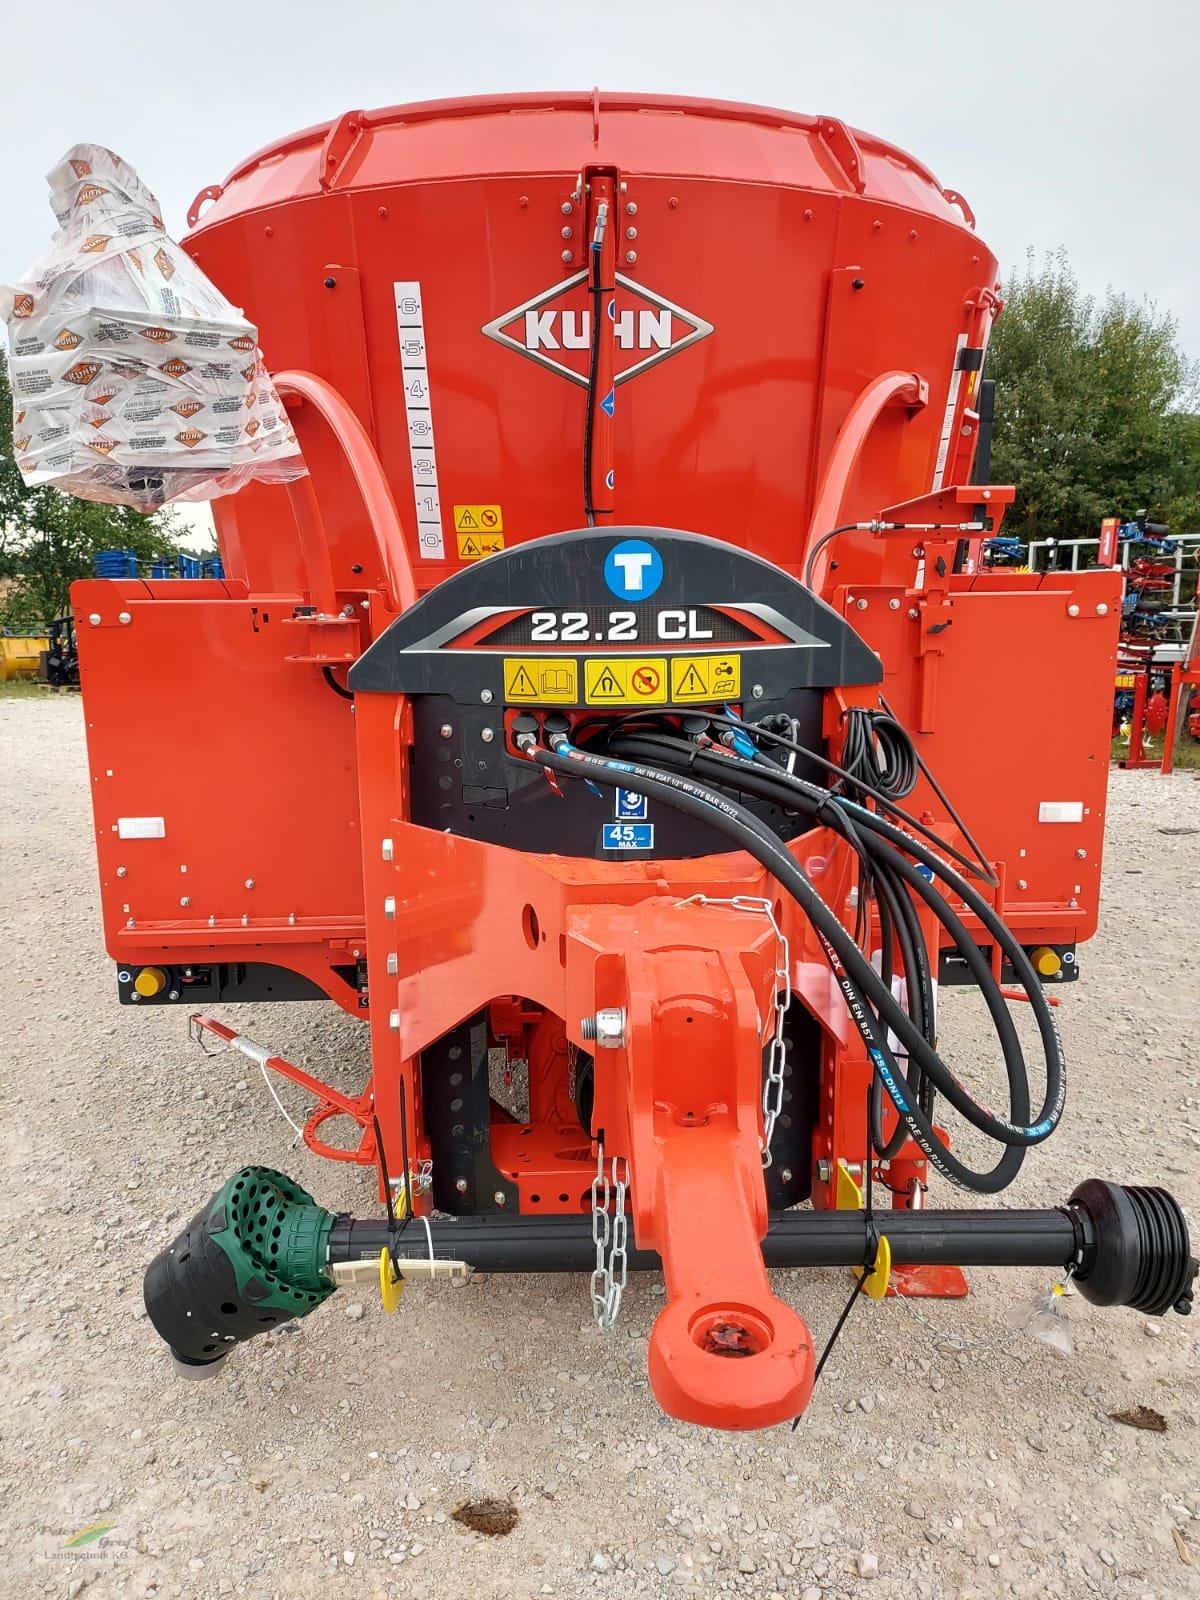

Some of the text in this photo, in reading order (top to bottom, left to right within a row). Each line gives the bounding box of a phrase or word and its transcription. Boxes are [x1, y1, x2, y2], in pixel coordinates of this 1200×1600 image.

[400, 297, 417, 315] 6
[525, 310, 672, 349] KUHN
[404, 339, 421, 356] 5
[68, 365, 97, 380] KUHN
[410, 380, 424, 398] 4
[176, 402, 200, 411] KUHN
[413, 420, 429, 436] 3
[180, 432, 203, 441] KUHN
[416, 459, 433, 475] 2
[423, 497, 434, 511] 1
[424, 533, 438, 547] 0
[614, 553, 652, 590] T
[531, 610, 712, 641] 22.2 CL
[683, 783, 694, 792] WP
[694, 786, 705, 797] 275
[704, 792, 719, 806] BAR
[610, 826, 635, 841] 45
[842, 980, 856, 1001] DIN
[851, 1003, 864, 1019] EN
[860, 1021, 874, 1040] 857
[873, 1053, 889, 1075] 2SC
[906, 1116, 922, 1137] SAE
[919, 1138, 933, 1153] 100
[930, 1154, 949, 1173] R2AT
